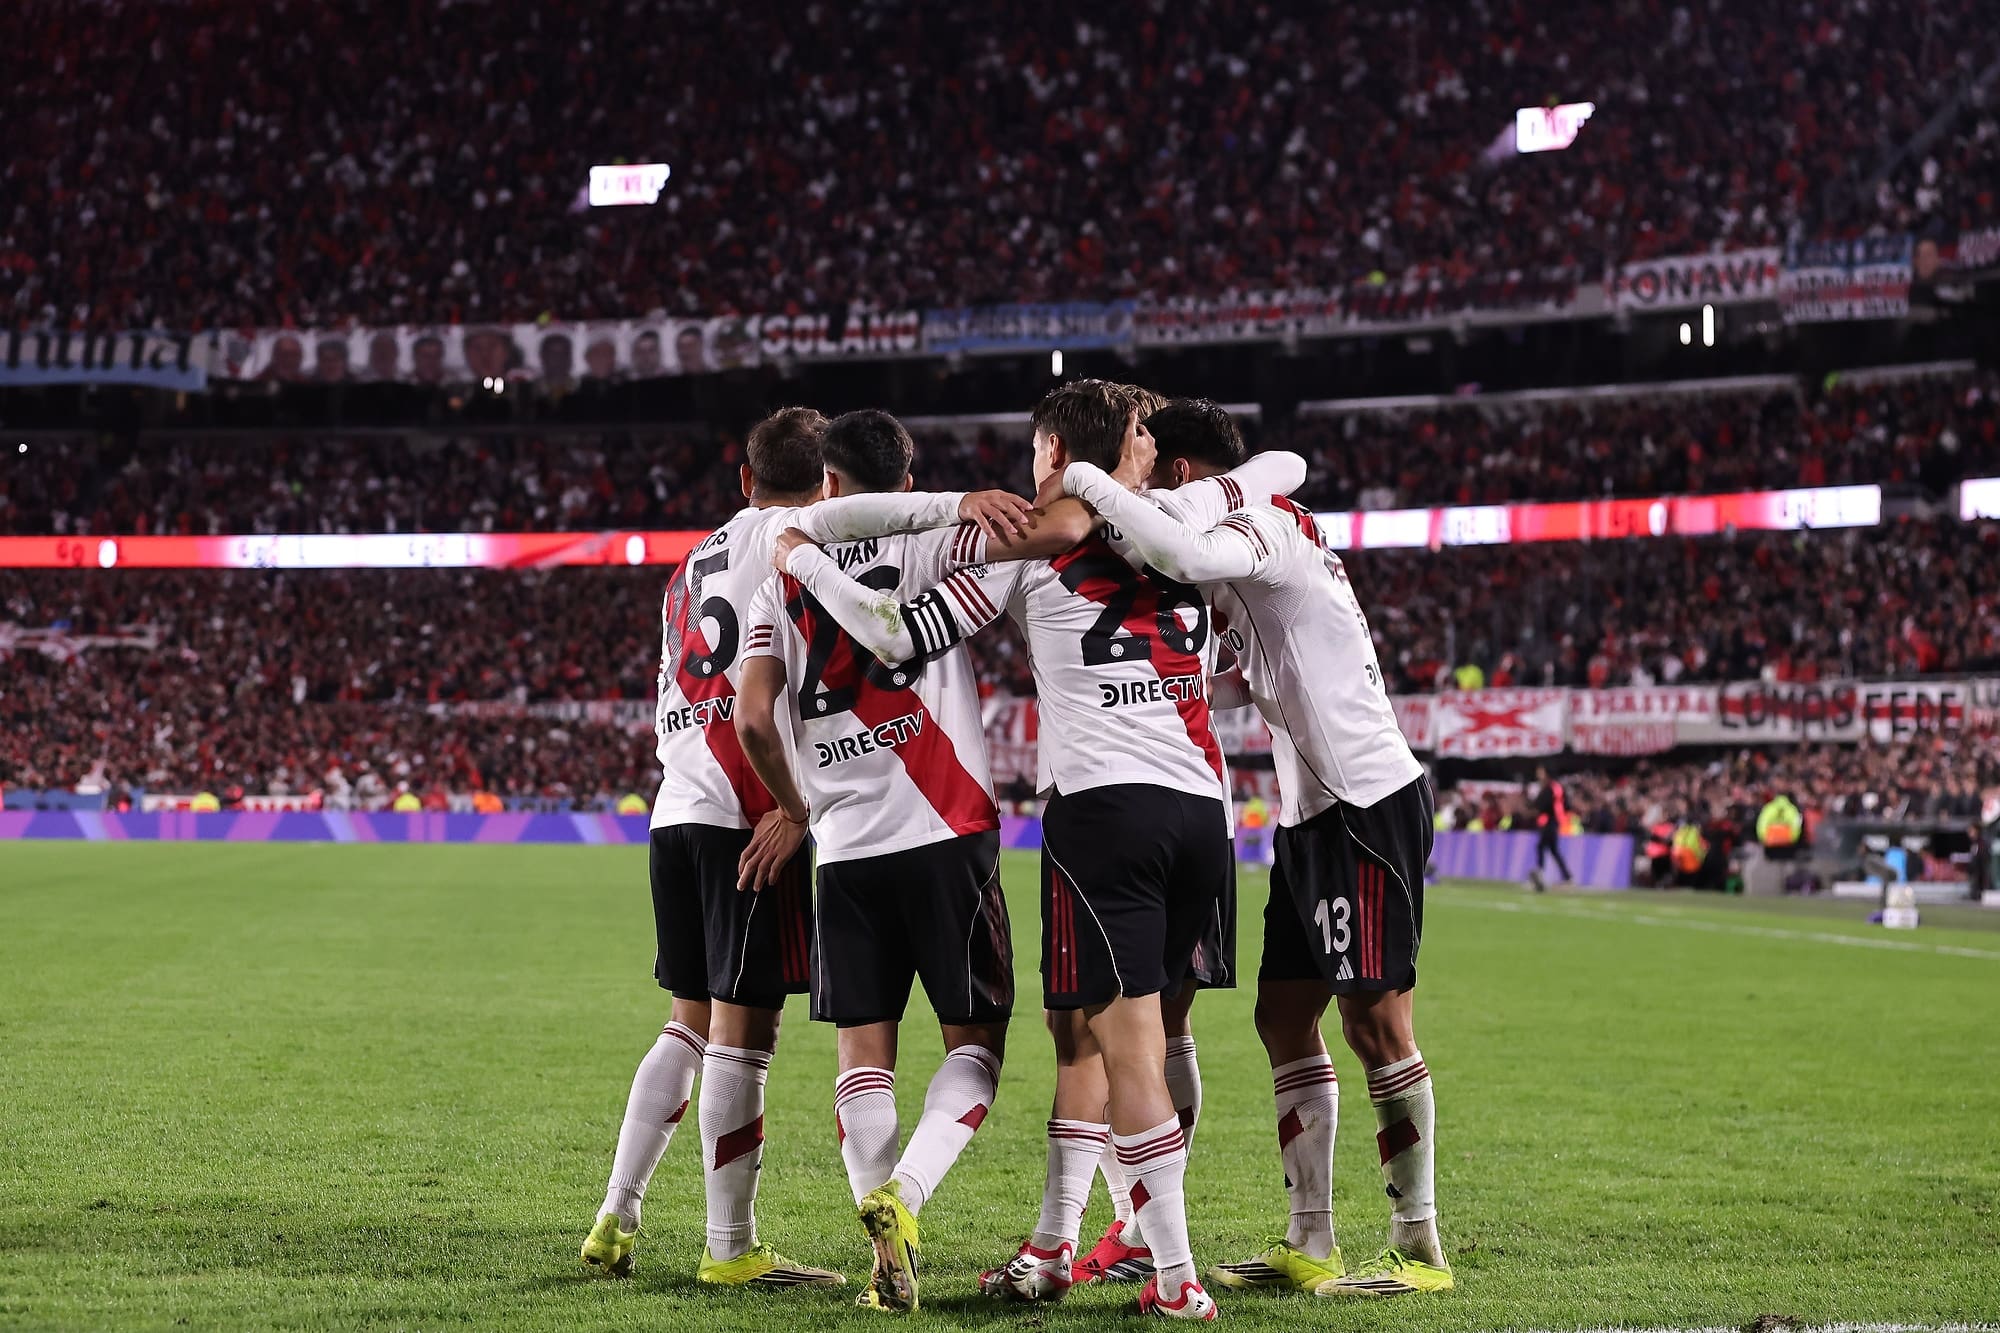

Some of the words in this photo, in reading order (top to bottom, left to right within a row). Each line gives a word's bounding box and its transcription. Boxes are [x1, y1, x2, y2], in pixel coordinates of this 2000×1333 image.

[762, 311, 918, 353] SOLANO
[1098, 676, 1201, 708] DIRECTV
[814, 709, 924, 769] DIRECTV
[1314, 896, 1351, 954] 13
